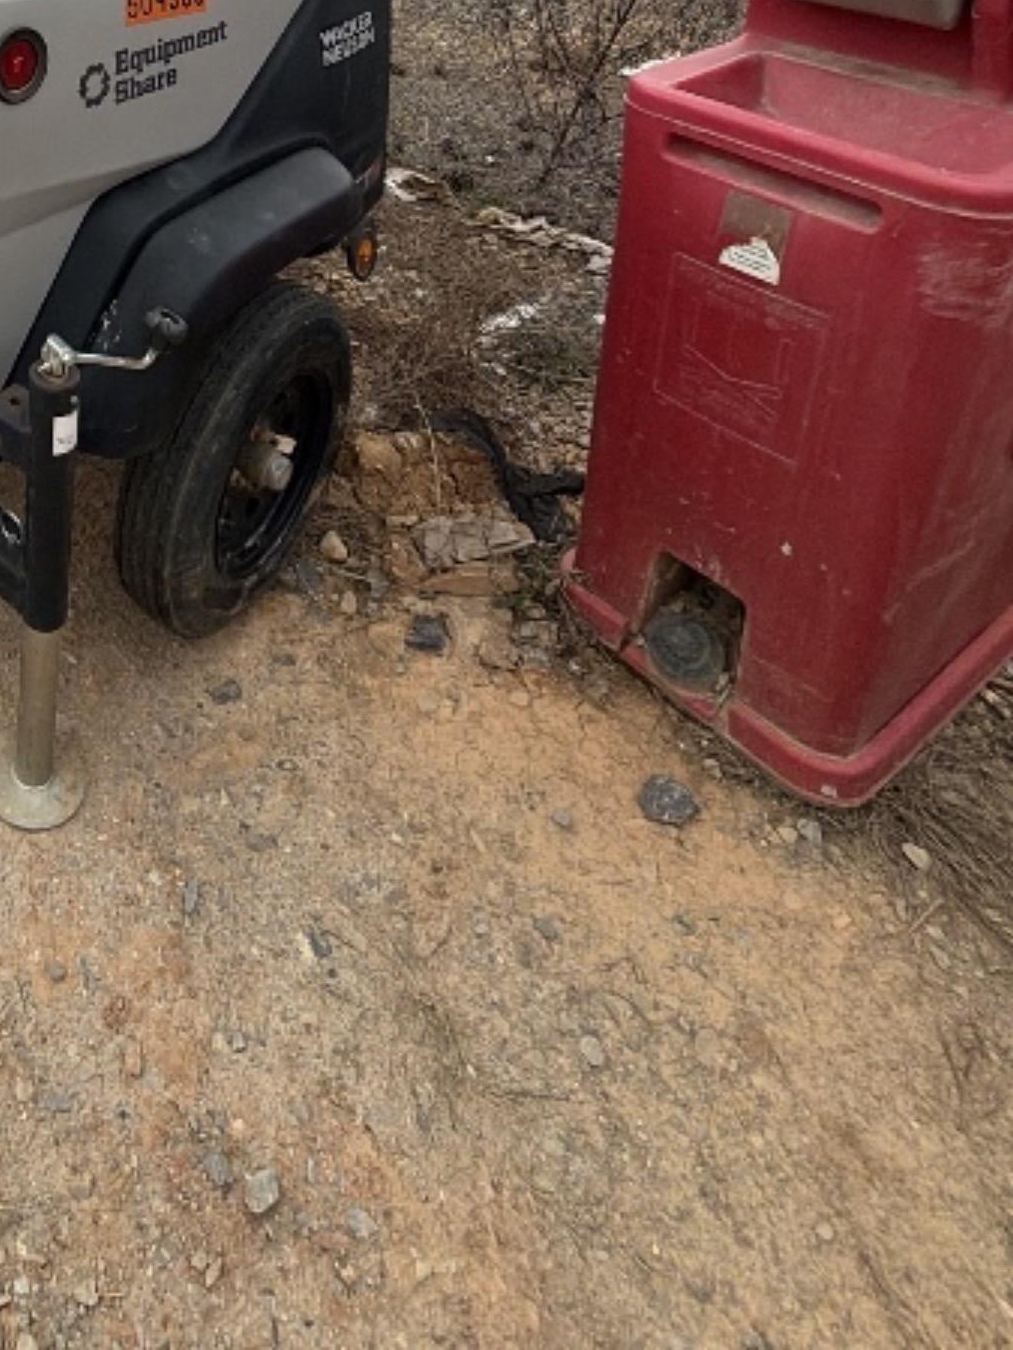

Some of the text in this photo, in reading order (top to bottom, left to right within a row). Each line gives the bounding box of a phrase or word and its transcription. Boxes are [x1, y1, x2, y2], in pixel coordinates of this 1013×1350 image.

[114, 20, 228, 74] Equipment
[319, 10, 373, 48] WACKER
[114, 68, 178, 106] Share
